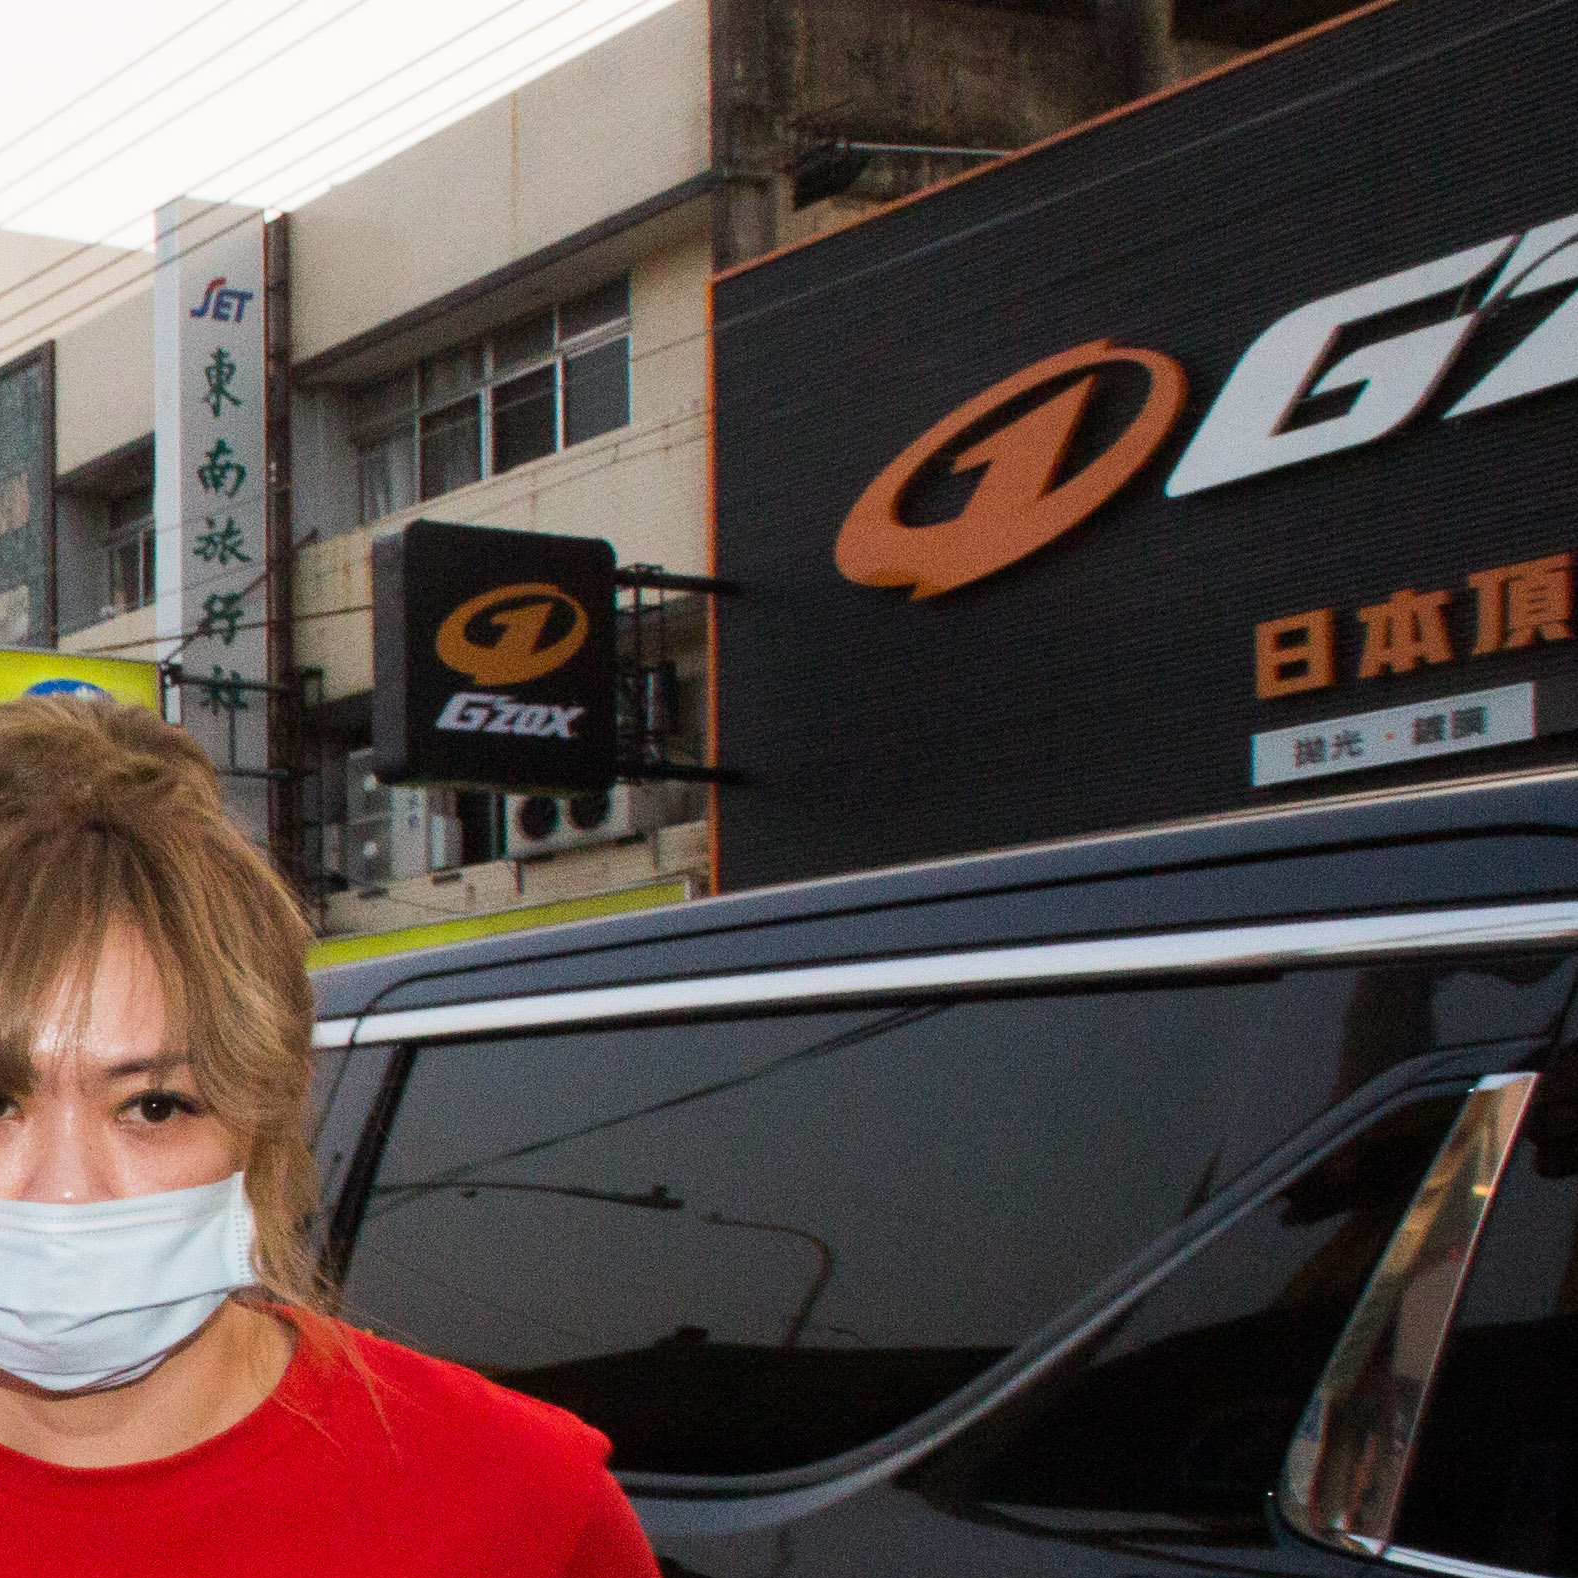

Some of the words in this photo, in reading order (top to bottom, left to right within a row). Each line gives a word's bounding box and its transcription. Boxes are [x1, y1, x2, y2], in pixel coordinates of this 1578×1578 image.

[190, 276, 255, 324] SET
[1255, 551, 1577, 700] 日本頂
